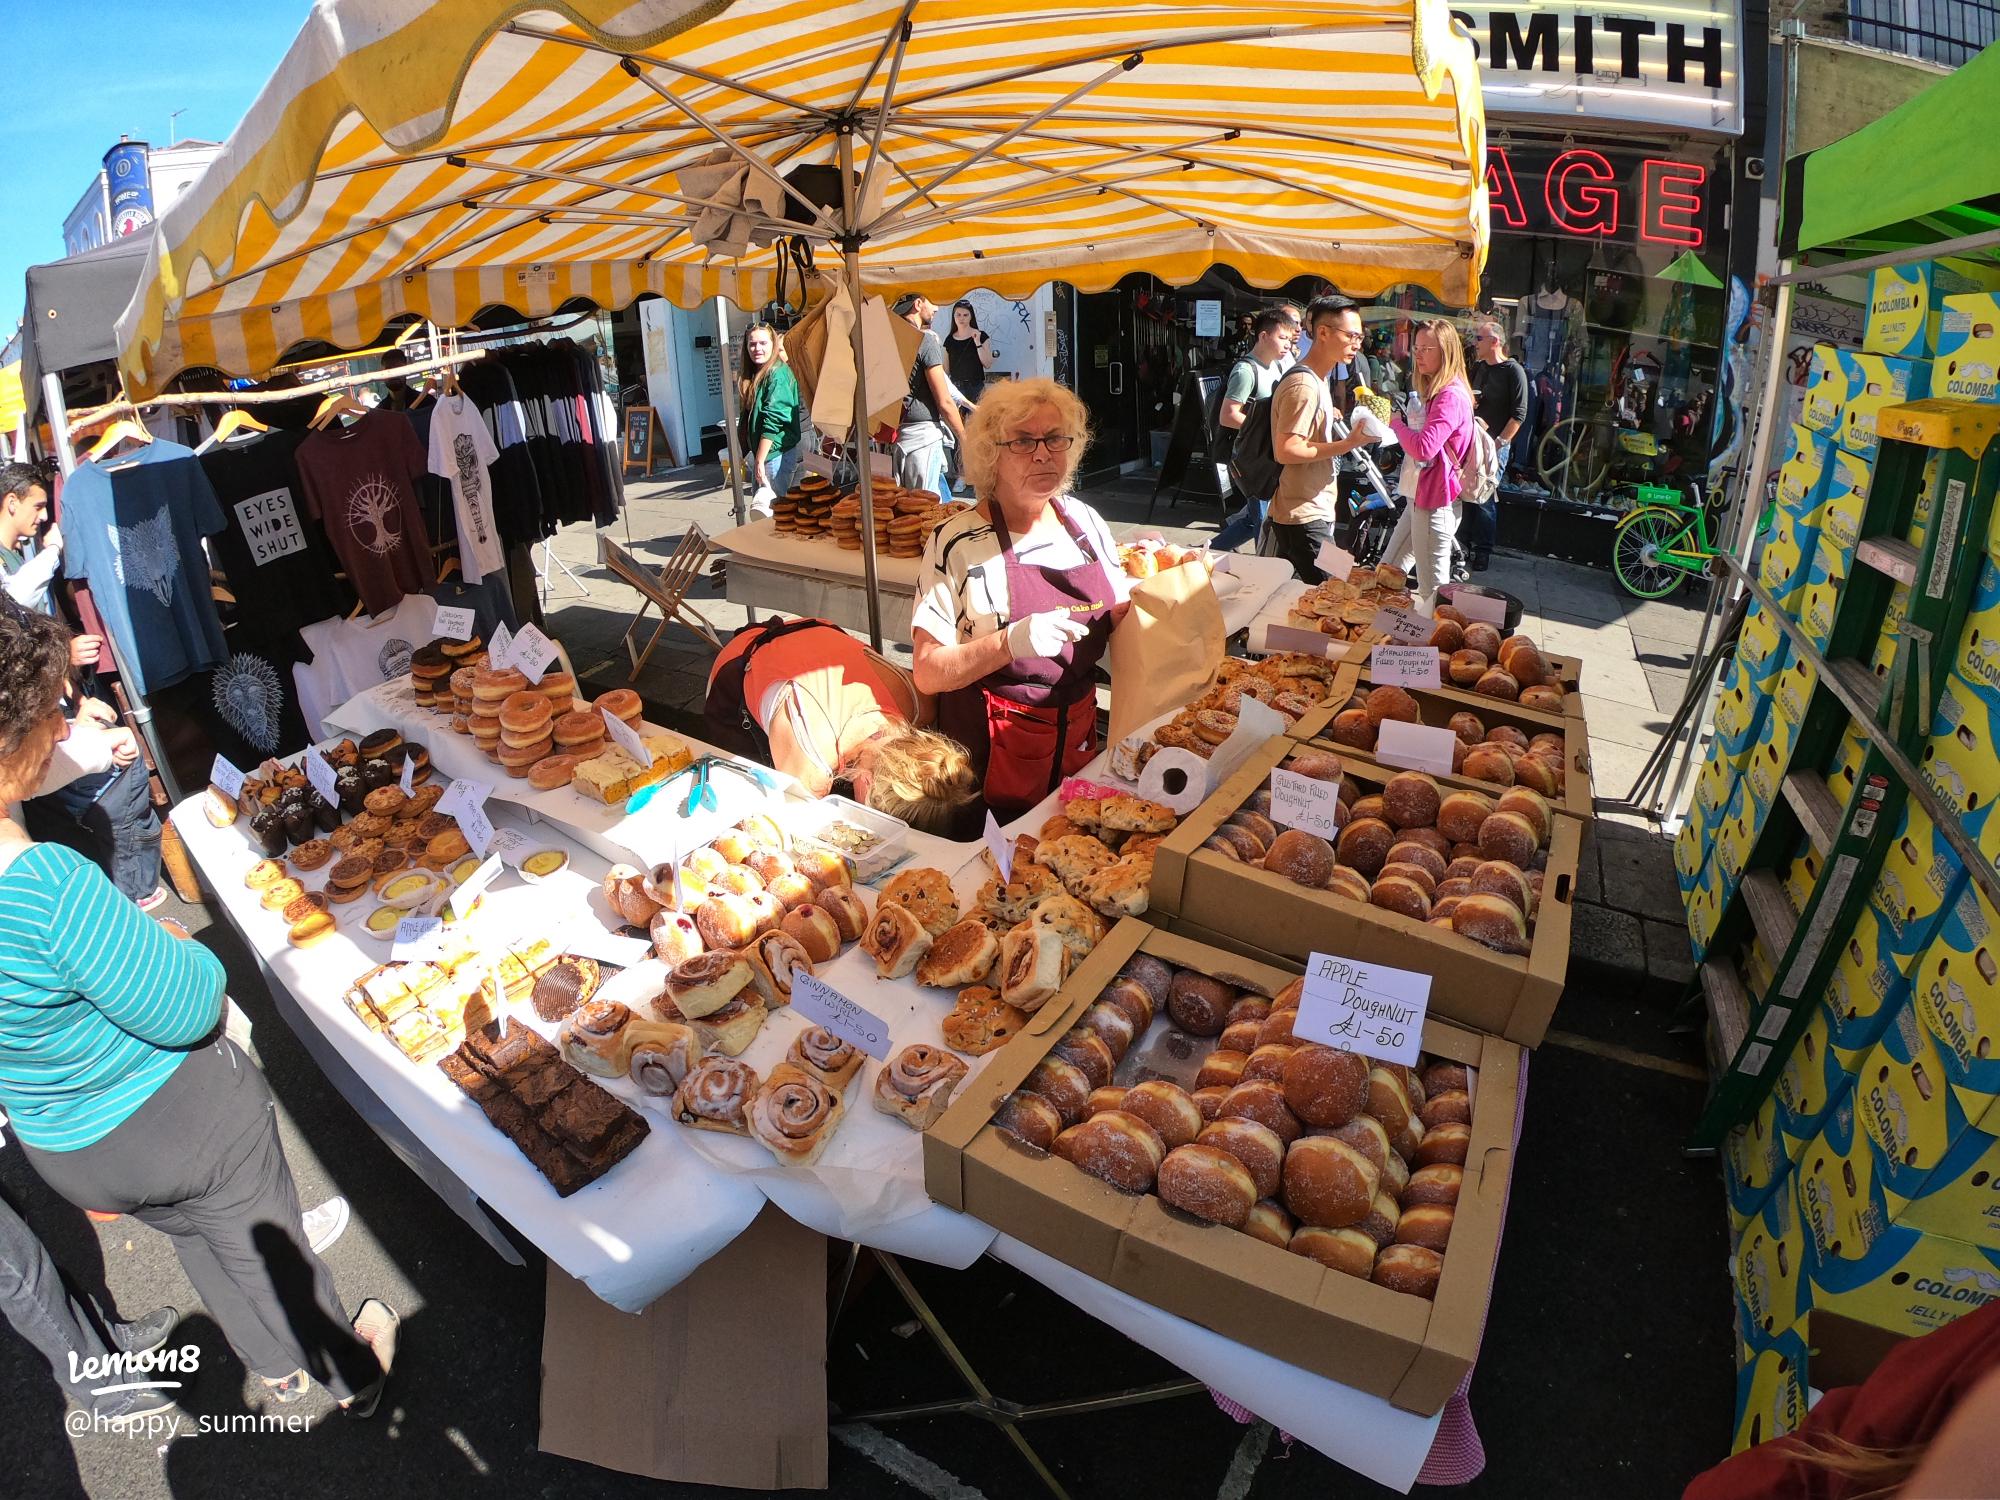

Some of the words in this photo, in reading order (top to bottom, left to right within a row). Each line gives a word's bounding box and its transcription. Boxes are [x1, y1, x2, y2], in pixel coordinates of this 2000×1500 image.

[1878, 297, 1910, 313] COLOMBA
[1947, 380, 1996, 398] COLOMBA
[244, 495, 286, 520] EYES
[249, 514, 294, 539] WIDE
[257, 532, 298, 559] SHUT
[1401, 665, 1429, 676] £1-50
[1274, 787, 1313, 810] DOUGHNUT
[1275, 774, 1307, 794] CUSTARD
[1309, 783, 1329, 801] FILLED
[1295, 808, 1331, 830] £1-50
[1875, 880, 1904, 940] OLOMBA
[1318, 959, 1368, 988] APPLE
[1341, 987, 1418, 1026] DOUGHNUT
[829, 1013, 878, 1043] £1-50
[1328, 1011, 1405, 1048] £1-50
[1930, 981, 1973, 1074] COLOMBA
[1870, 1086, 1900, 1178] COLOMBA
[1806, 1177, 1827, 1268] COLOMBA
[1744, 1250, 1762, 1339] COLOMBA
[1904, 1304, 1946, 1321] JELLY
[1786, 1353, 1798, 1432] LOMBA
